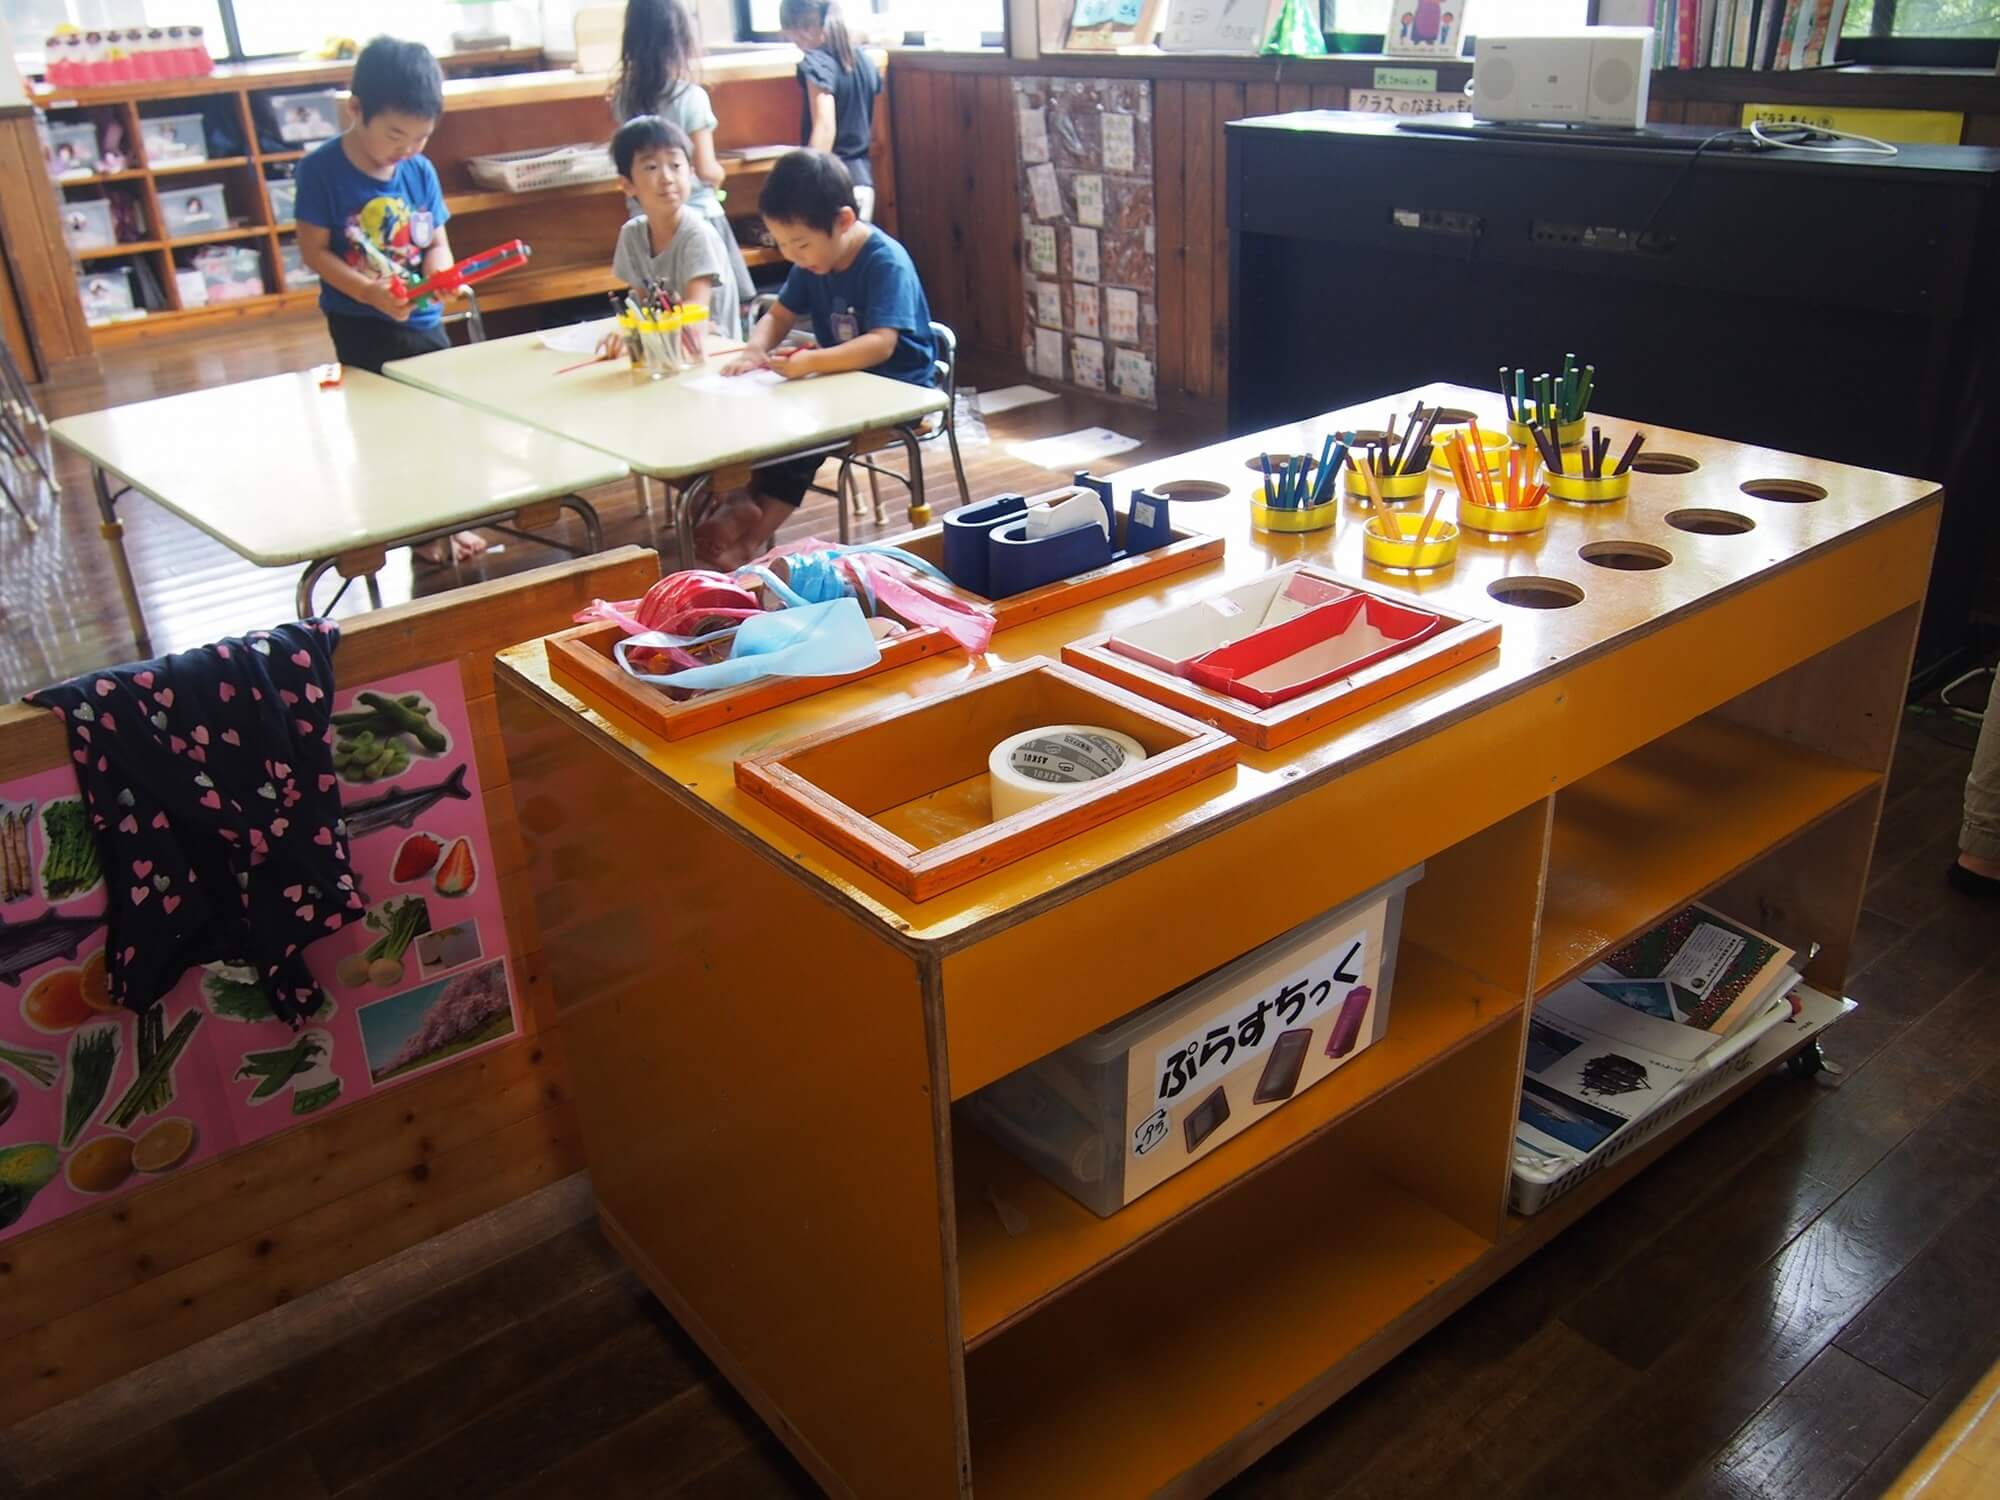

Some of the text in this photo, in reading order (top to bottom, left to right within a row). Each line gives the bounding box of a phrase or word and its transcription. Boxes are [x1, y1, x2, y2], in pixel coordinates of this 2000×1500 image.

[1023, 753, 1049, 764] ASKUL
[1158, 941, 1362, 1099] ぷらすちっく
